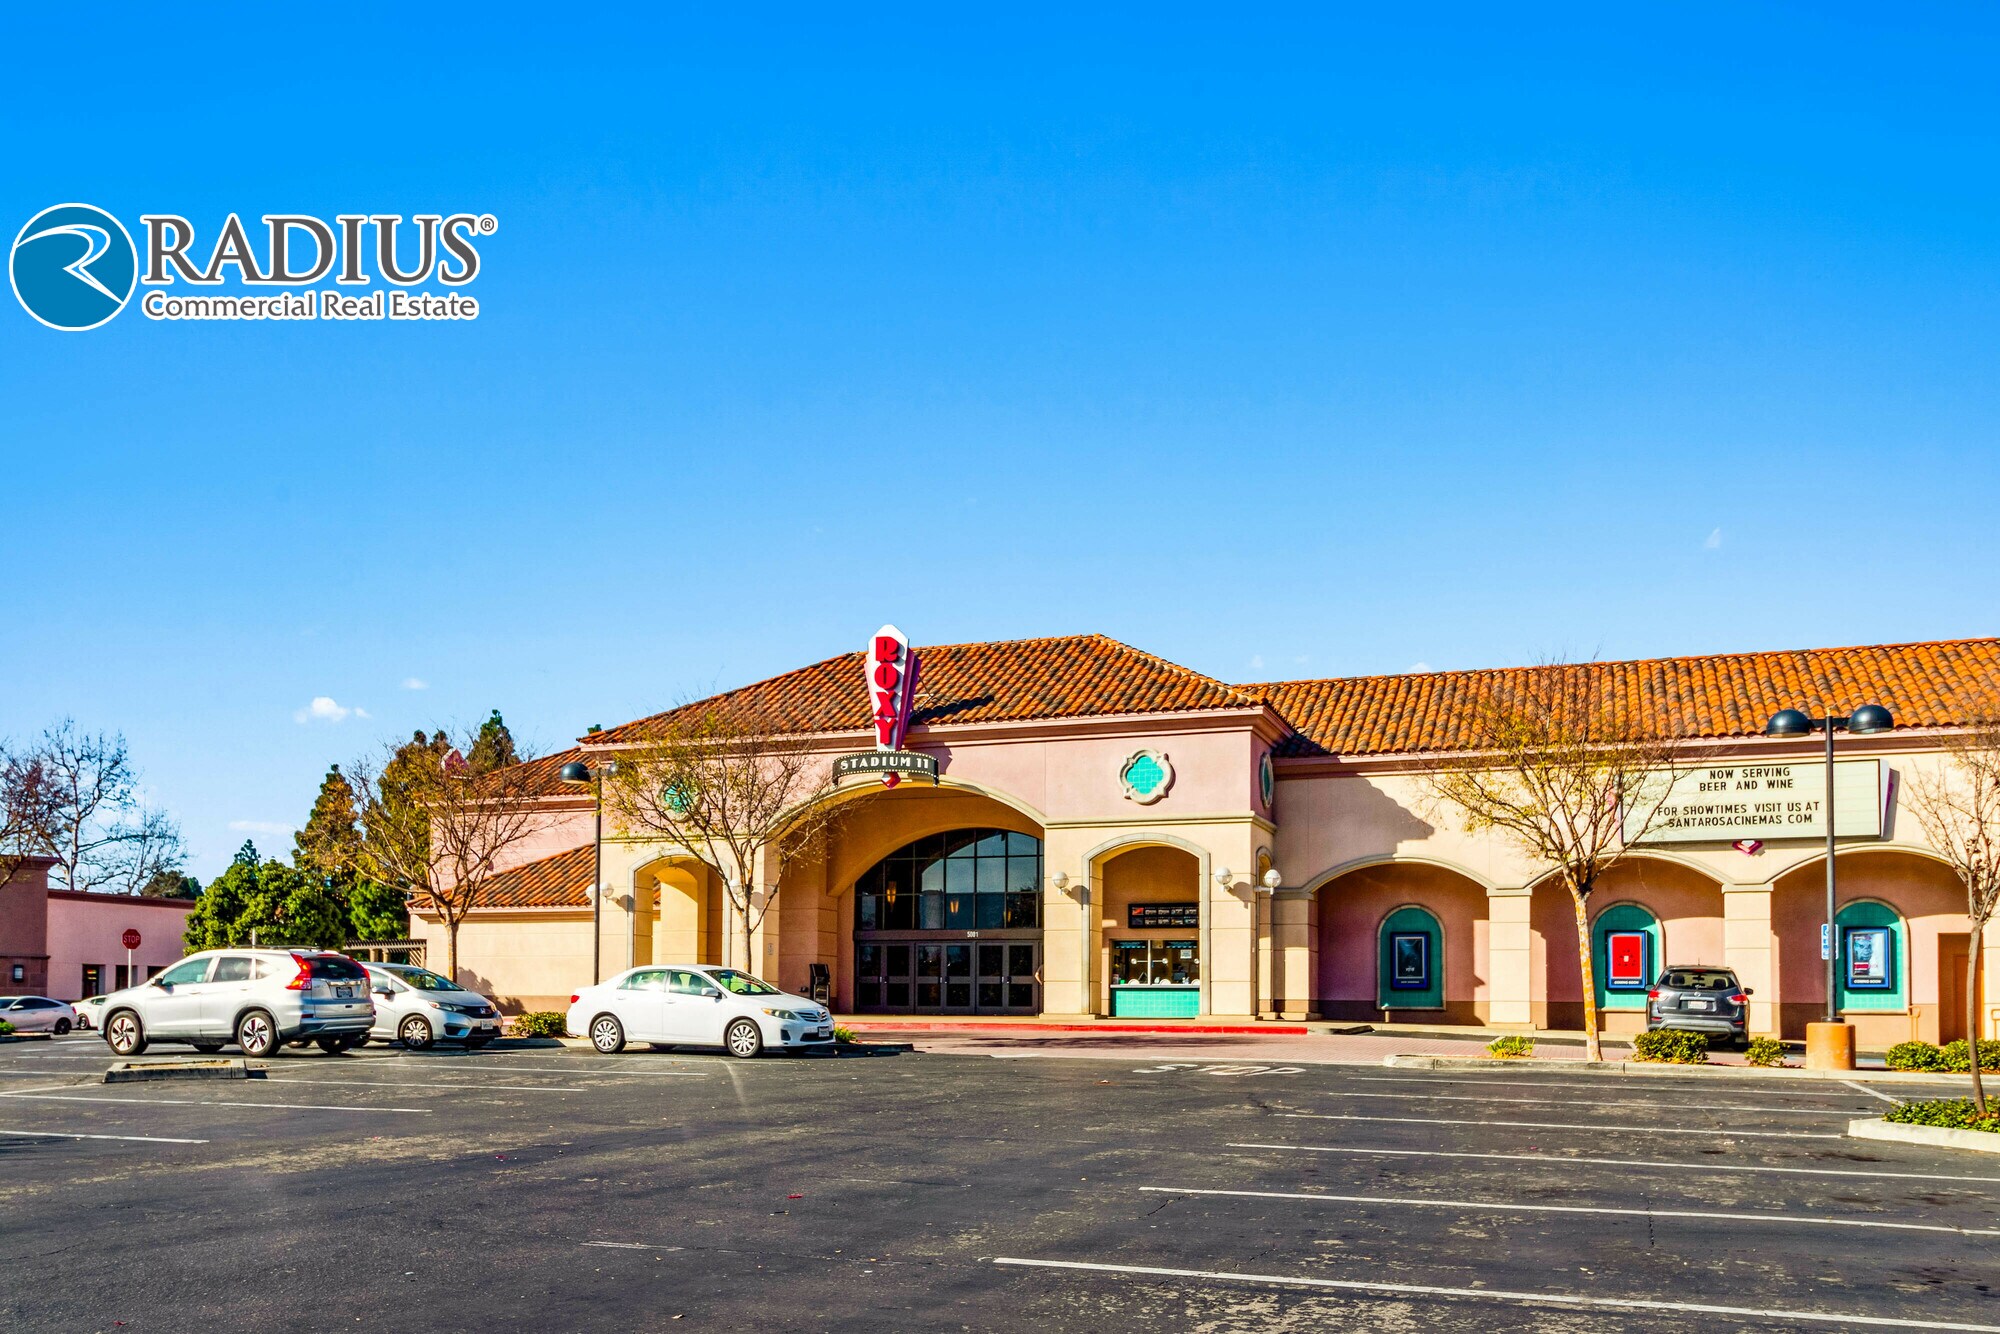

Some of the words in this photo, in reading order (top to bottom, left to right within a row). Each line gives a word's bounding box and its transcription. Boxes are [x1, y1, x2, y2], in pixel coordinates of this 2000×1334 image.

[874, 636, 899, 745] ROXY
[840, 756, 911, 771] STADIUM
[916, 758, 929, 769] 11
[1709, 769, 1734, 780] NOW
[1742, 767, 1791, 778] SERVING
[1700, 781, 1727, 792] BEER
[1736, 780, 1758, 790] AND
[1766, 779, 1793, 789] WINE
[1657, 806, 1678, 816] FOR
[1683, 804, 1747, 815] SHOWTIMES
[1754, 803, 1782, 813] VISIT
[1787, 802, 1801, 812] US
[1805, 801, 1820, 811] AT
[1668, 814, 1782, 828] SANTAROSACINEMAS
[1787, 813, 1813, 824] COM
[123, 935, 140, 943] STOP
[1132, 1063, 1307, 1077] STOP
